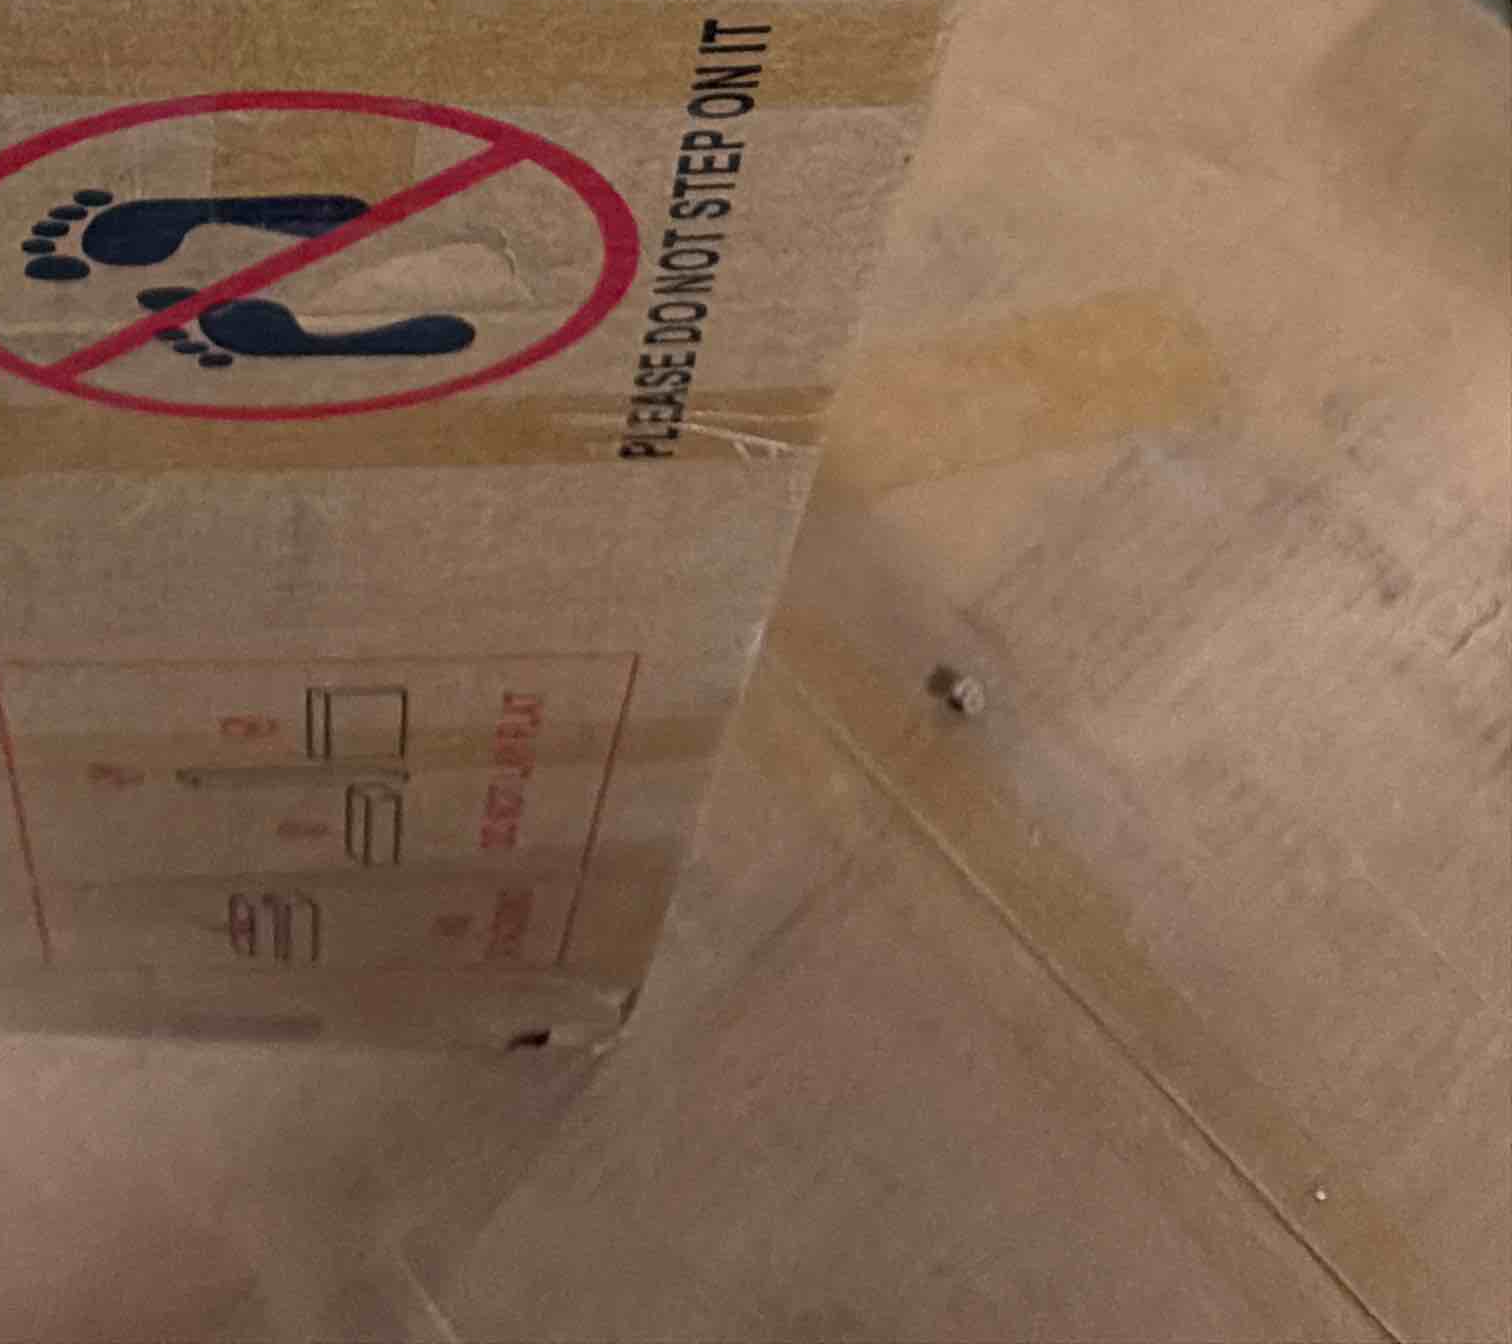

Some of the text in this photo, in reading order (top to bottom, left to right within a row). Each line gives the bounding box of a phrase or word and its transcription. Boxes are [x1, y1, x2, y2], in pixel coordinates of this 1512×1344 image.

[618, 17, 773, 461] PLEASE DO NOT STEP ON IT
